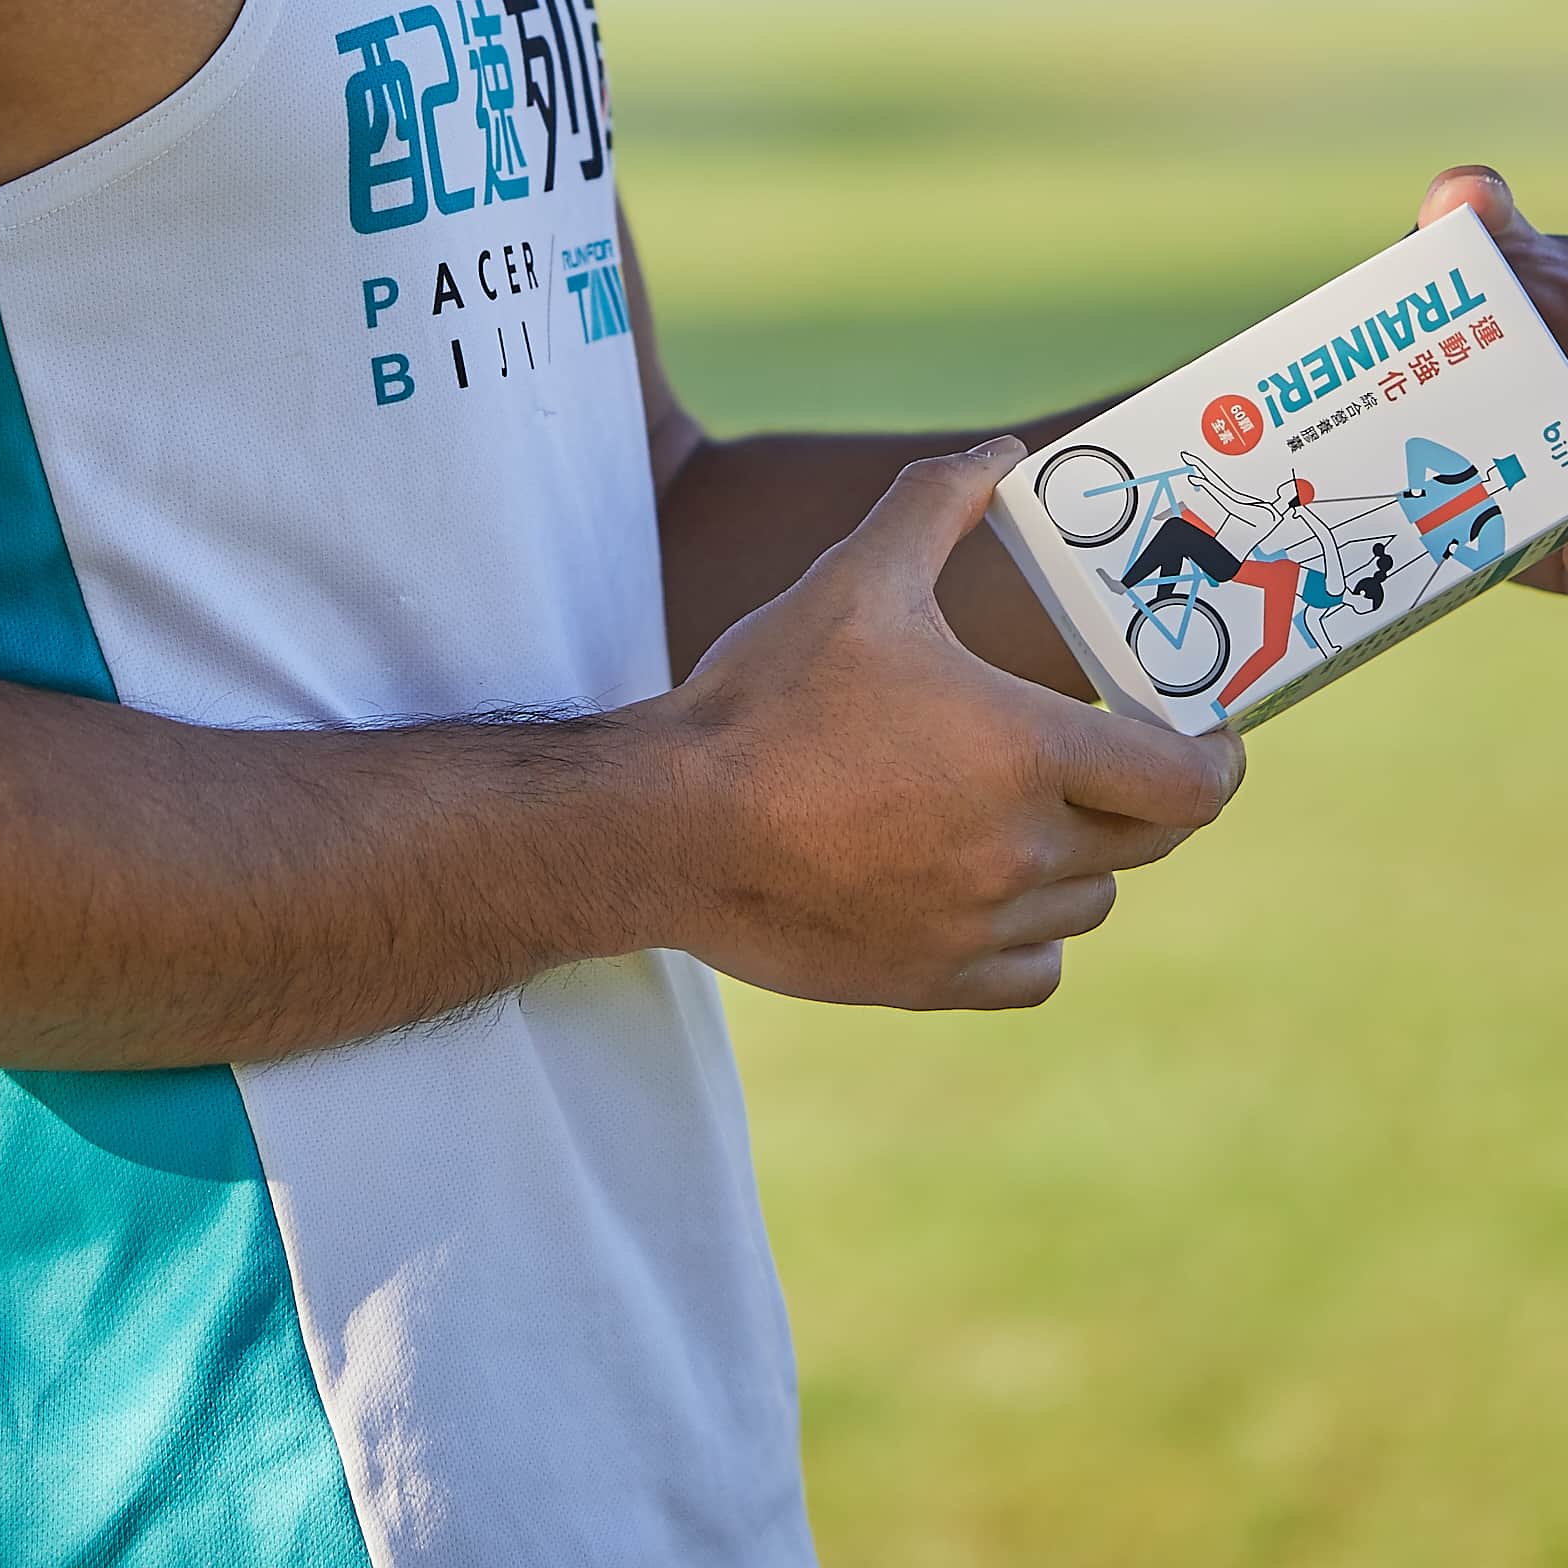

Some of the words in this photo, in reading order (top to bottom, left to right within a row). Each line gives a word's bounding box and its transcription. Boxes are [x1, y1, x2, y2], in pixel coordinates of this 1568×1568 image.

[362, 241, 540, 329] PACER
[370, 321, 535, 406] BIJI
[1257, 267, 1487, 429] TRAINER!
[1377, 314, 1504, 403] 運動強化
